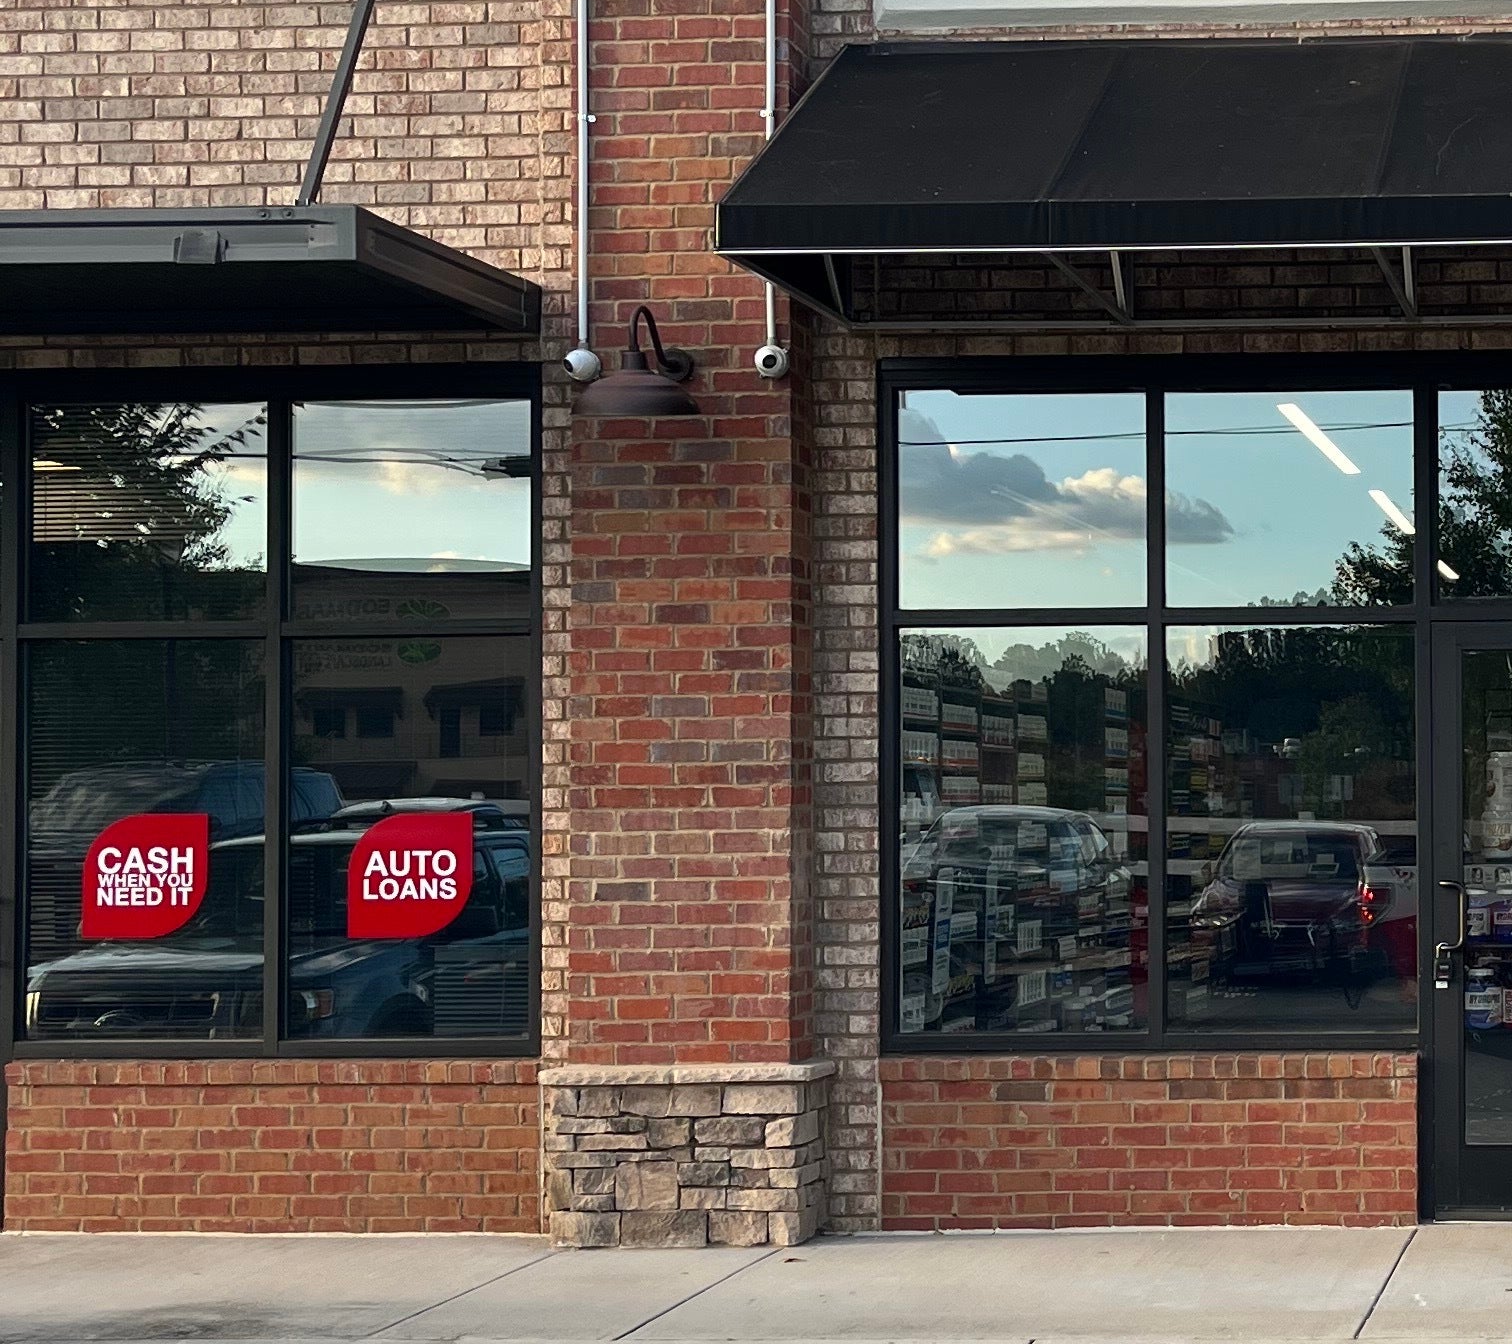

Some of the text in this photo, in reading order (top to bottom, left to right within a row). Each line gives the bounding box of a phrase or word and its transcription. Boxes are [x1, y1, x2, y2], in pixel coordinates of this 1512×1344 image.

[97, 846, 194, 874] CASH
[363, 849, 457, 877] AUTO
[97, 873, 193, 888] WHEN YOU
[362, 877, 458, 900] LOANS
[96, 886, 194, 906] NEED IT
